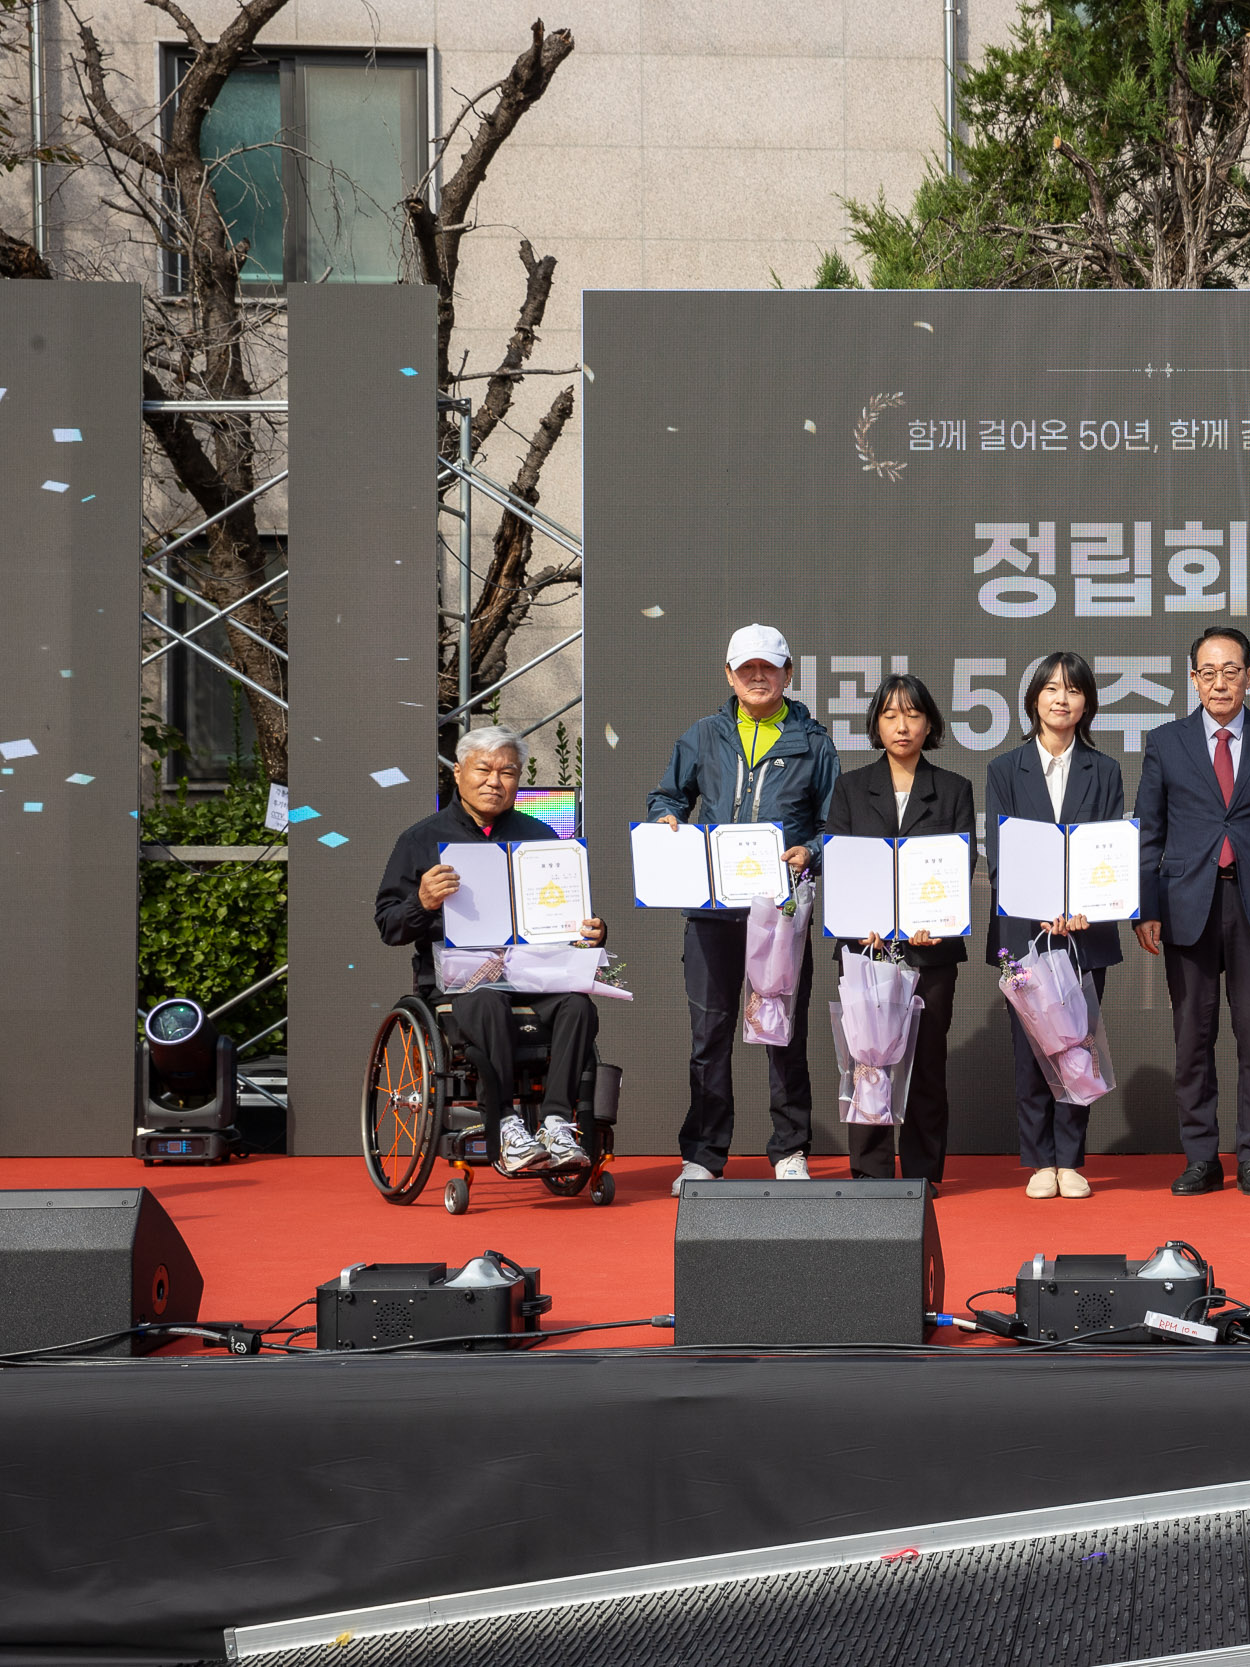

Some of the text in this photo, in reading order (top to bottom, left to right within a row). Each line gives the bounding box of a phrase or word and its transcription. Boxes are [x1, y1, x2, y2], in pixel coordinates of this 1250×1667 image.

[907, 419, 968, 452] 함께
[979, 419, 1069, 452] 걸어온
[1079, 419, 1160, 454] 50년,
[1169, 419, 1229, 452] 함께
